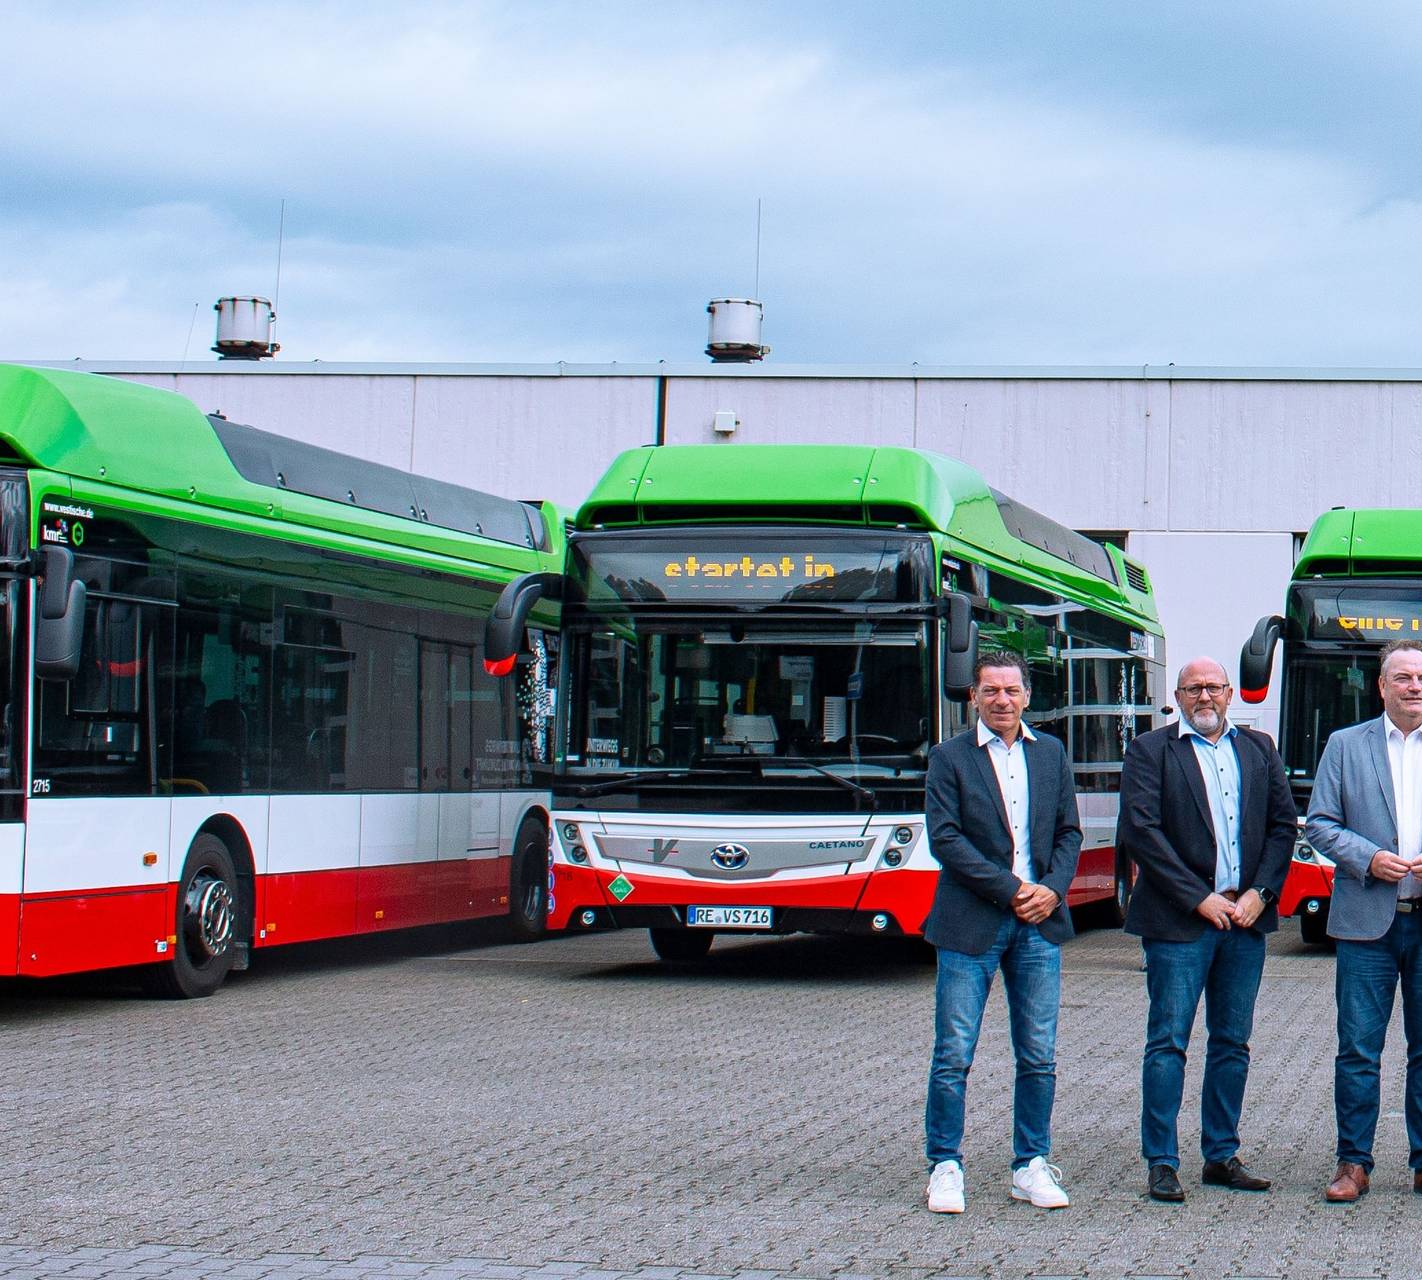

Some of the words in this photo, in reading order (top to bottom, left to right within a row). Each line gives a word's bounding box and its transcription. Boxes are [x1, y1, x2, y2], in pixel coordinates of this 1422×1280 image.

[804, 555, 835, 579] in
[33, 779, 51, 793] 2715
[809, 839, 866, 850] CAETANO
[696, 909, 715, 924] RE
